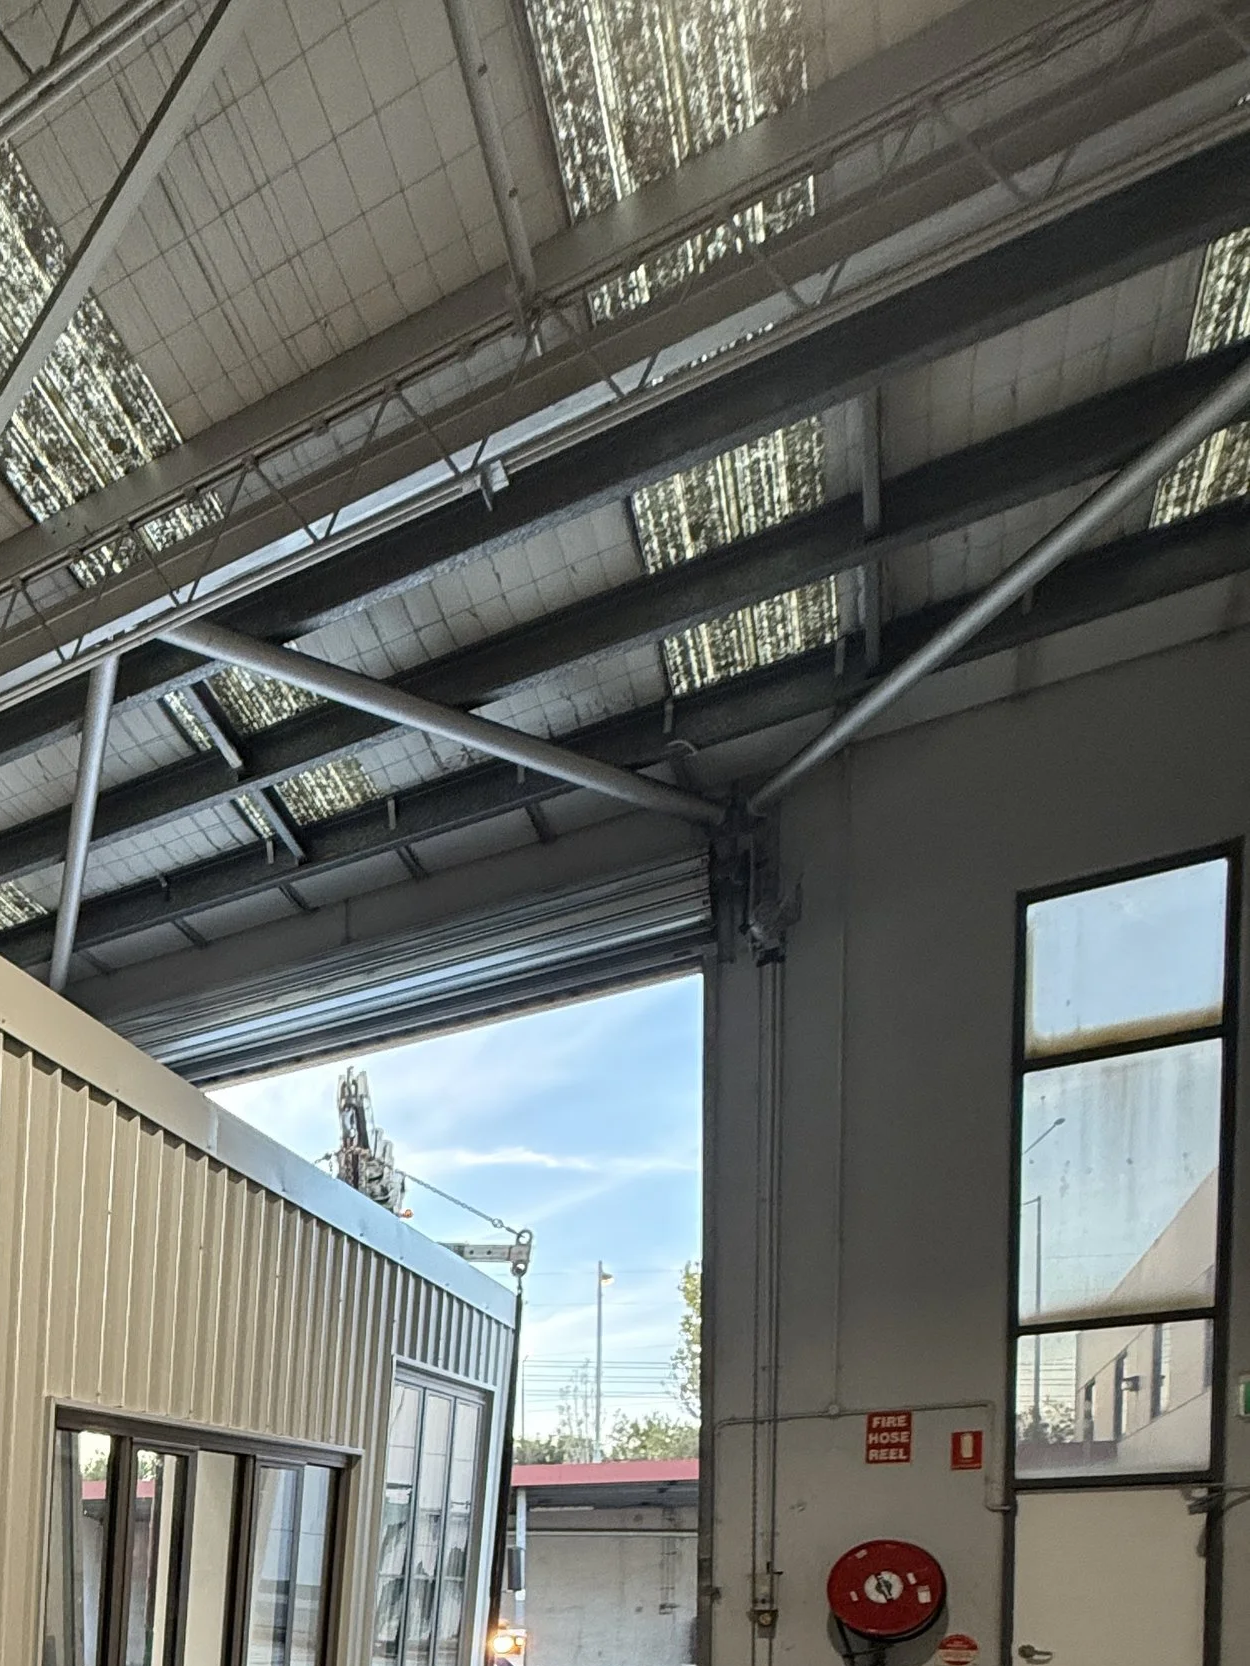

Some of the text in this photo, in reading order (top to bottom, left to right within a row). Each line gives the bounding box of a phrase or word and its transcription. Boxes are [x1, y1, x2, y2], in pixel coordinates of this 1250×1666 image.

[872, 1415, 907, 1428] FIRE
[869, 1431, 910, 1444] HOSE
[869, 1448, 908, 1461] REEL
